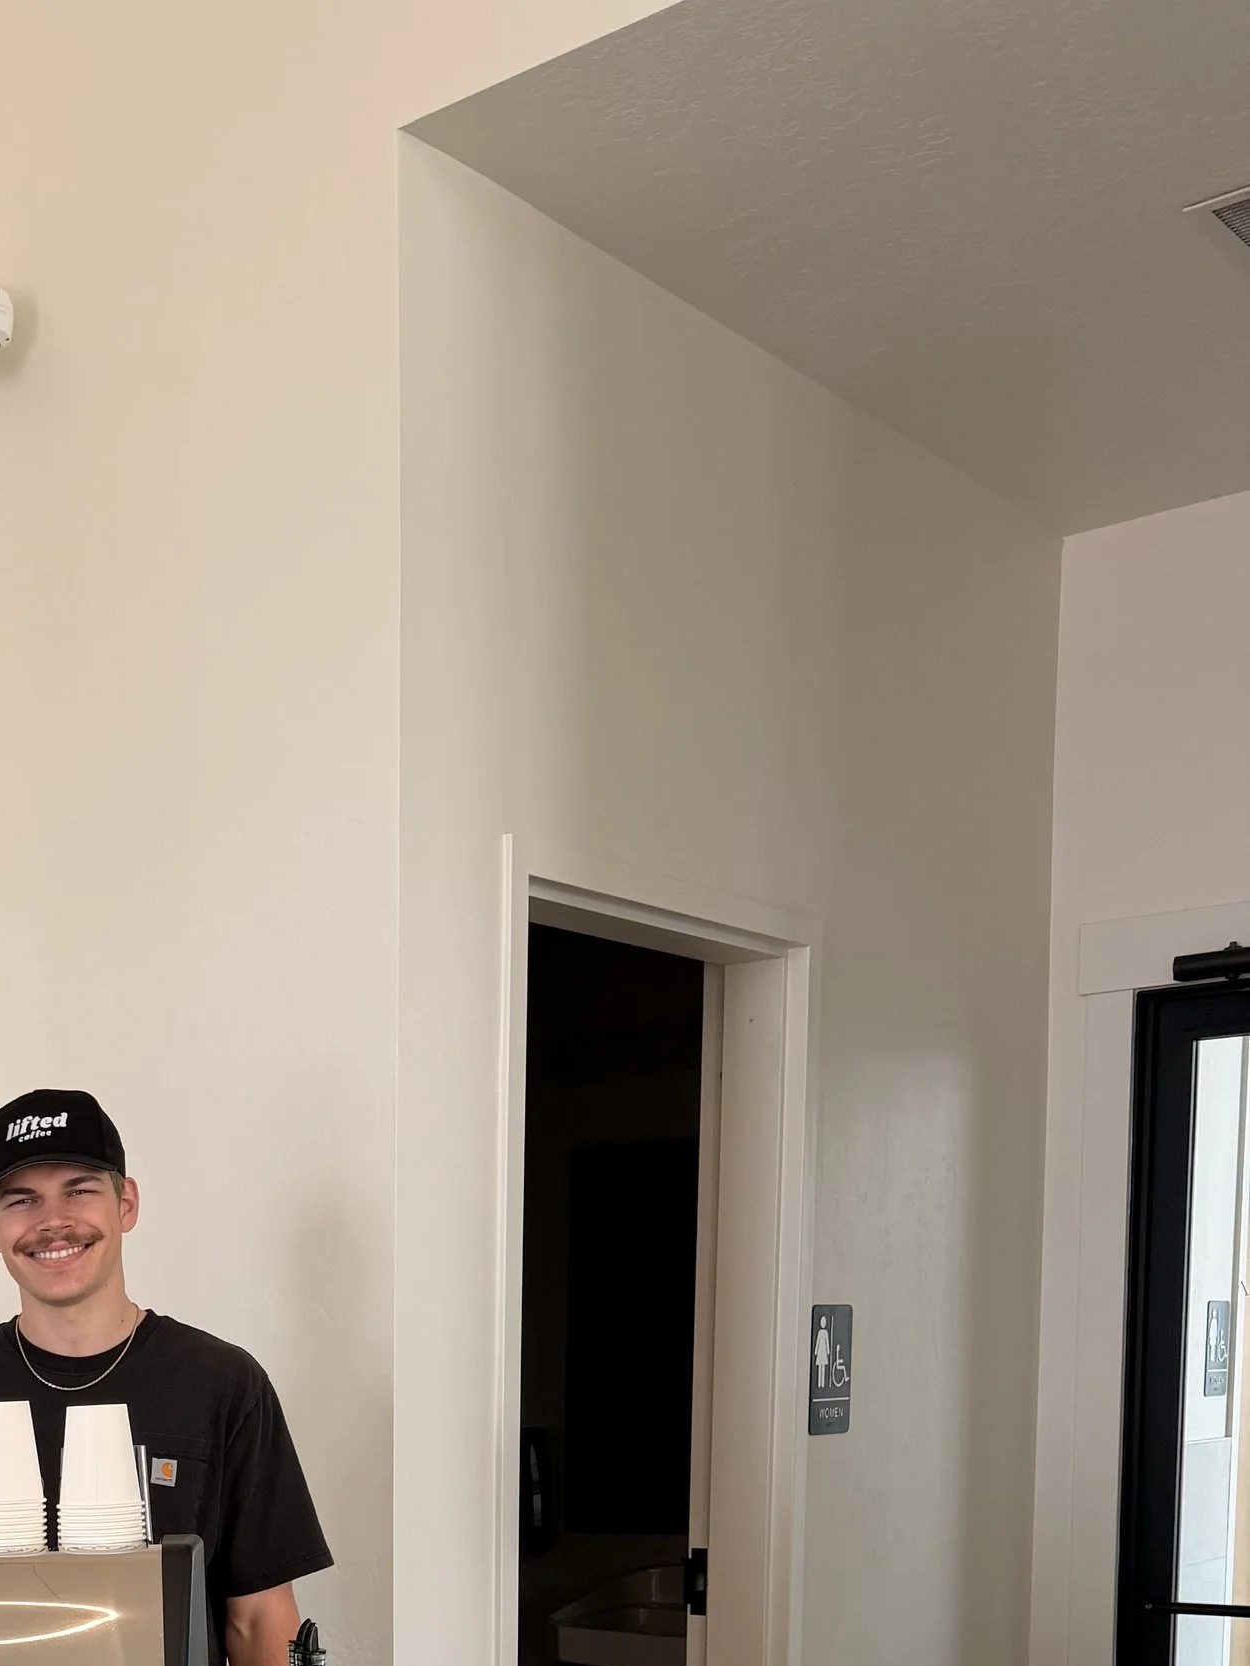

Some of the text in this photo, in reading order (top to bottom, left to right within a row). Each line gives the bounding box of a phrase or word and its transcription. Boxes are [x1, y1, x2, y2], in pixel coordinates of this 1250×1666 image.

[5, 1112, 68, 1141] lifted
[18, 1130, 52, 1142] coffee
[818, 1407, 844, 1418] WOMEN
